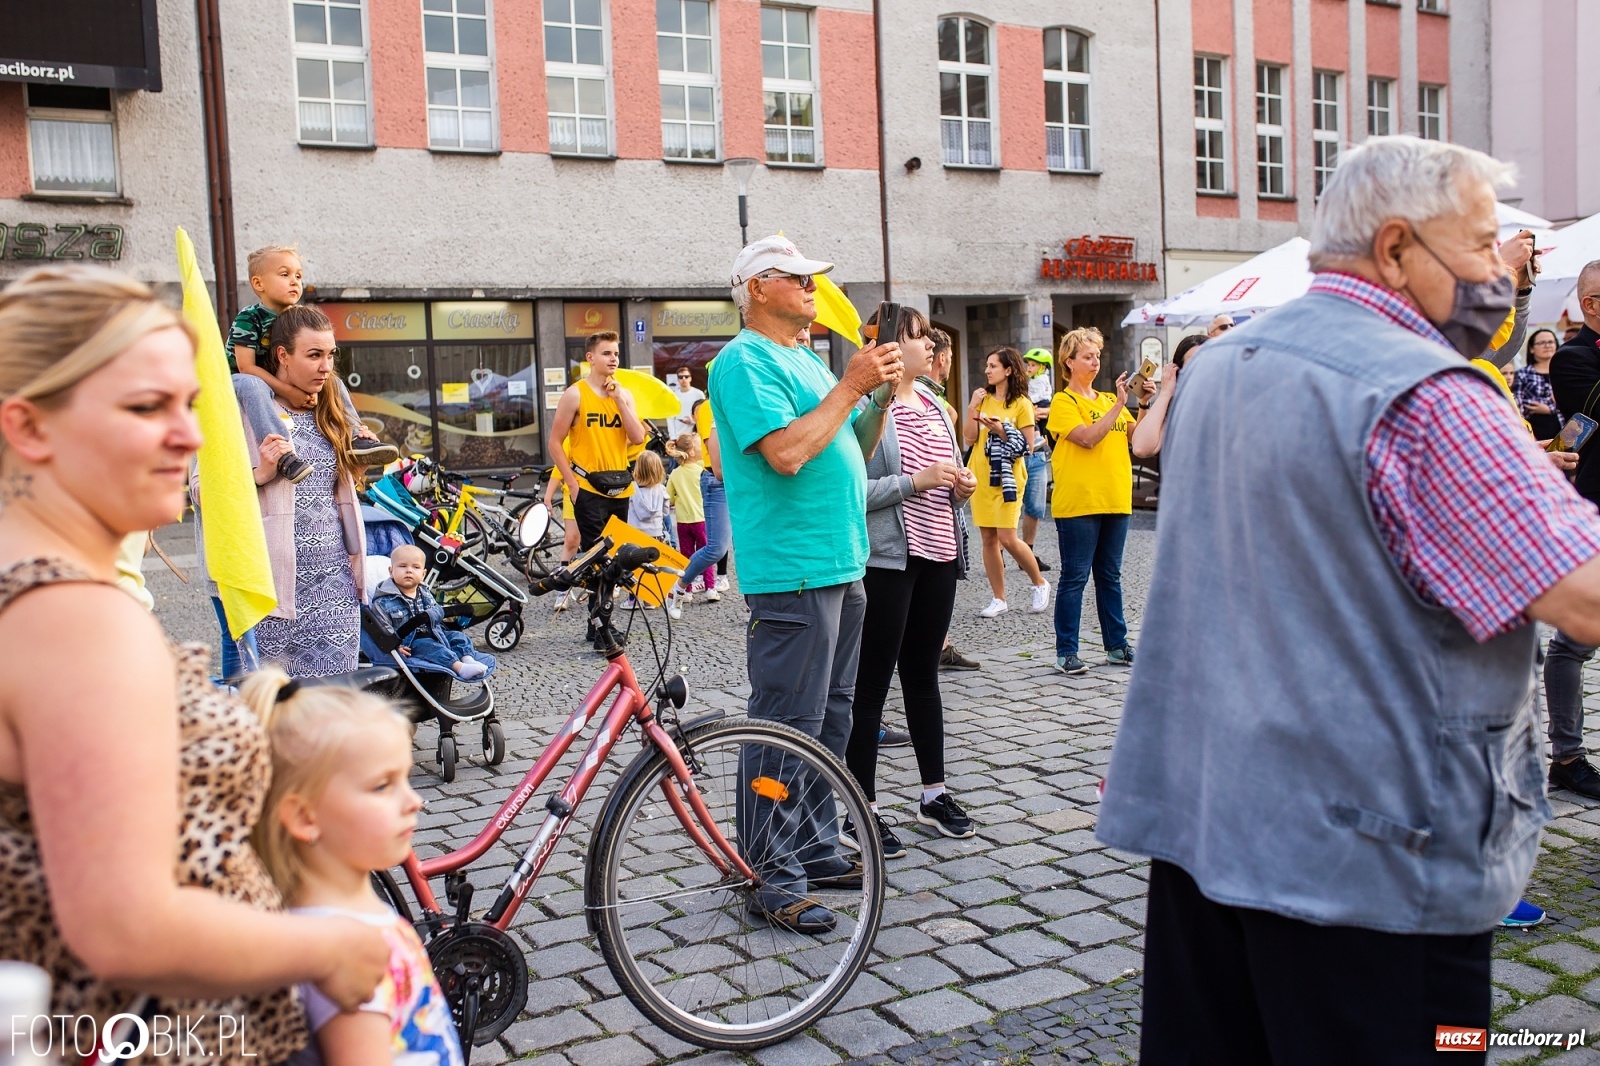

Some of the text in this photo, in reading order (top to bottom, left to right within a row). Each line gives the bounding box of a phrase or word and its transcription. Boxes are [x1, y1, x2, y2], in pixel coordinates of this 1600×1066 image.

[0, 222, 124, 261] sza
[345, 310, 407, 330] Ciasta
[637, 321, 643, 331] 7
[657, 308, 736, 333] Pieczywo
[586, 413, 622, 428] FILA
[496, 782, 535, 829] excursion
